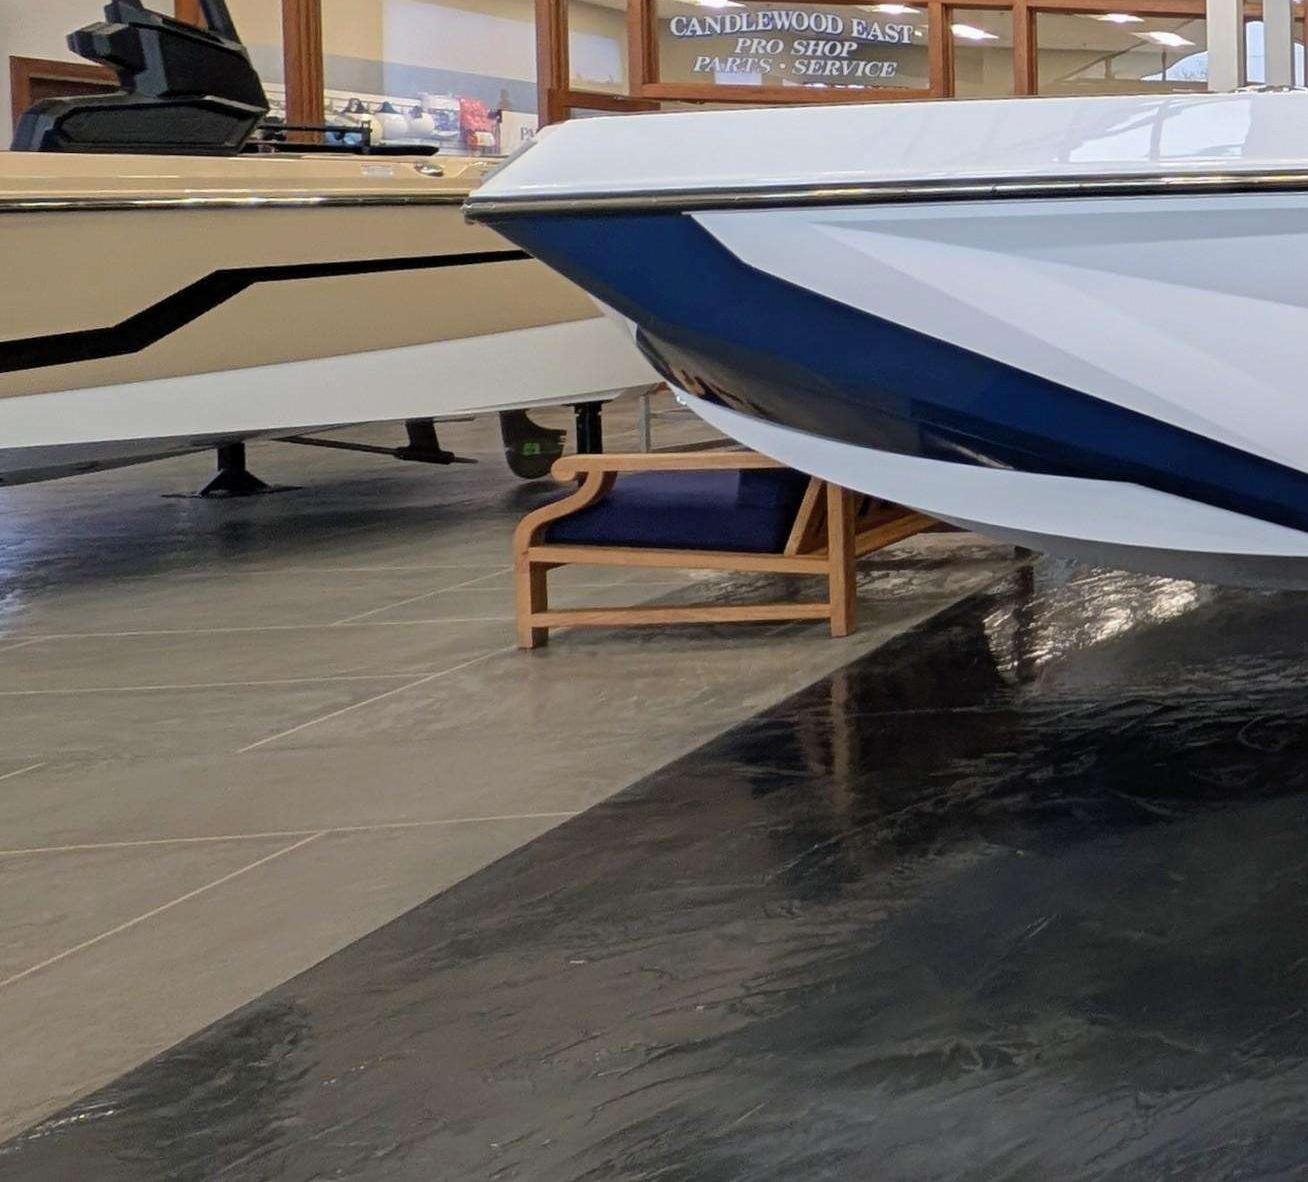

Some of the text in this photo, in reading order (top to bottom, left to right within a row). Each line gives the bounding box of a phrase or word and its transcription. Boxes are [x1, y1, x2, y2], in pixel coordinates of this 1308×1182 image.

[670, 10, 914, 44] CANDLEWOOD EAST
[734, 37, 858, 58] PRO SHOP
[693, 56, 897, 78] PARTS SERVICE
